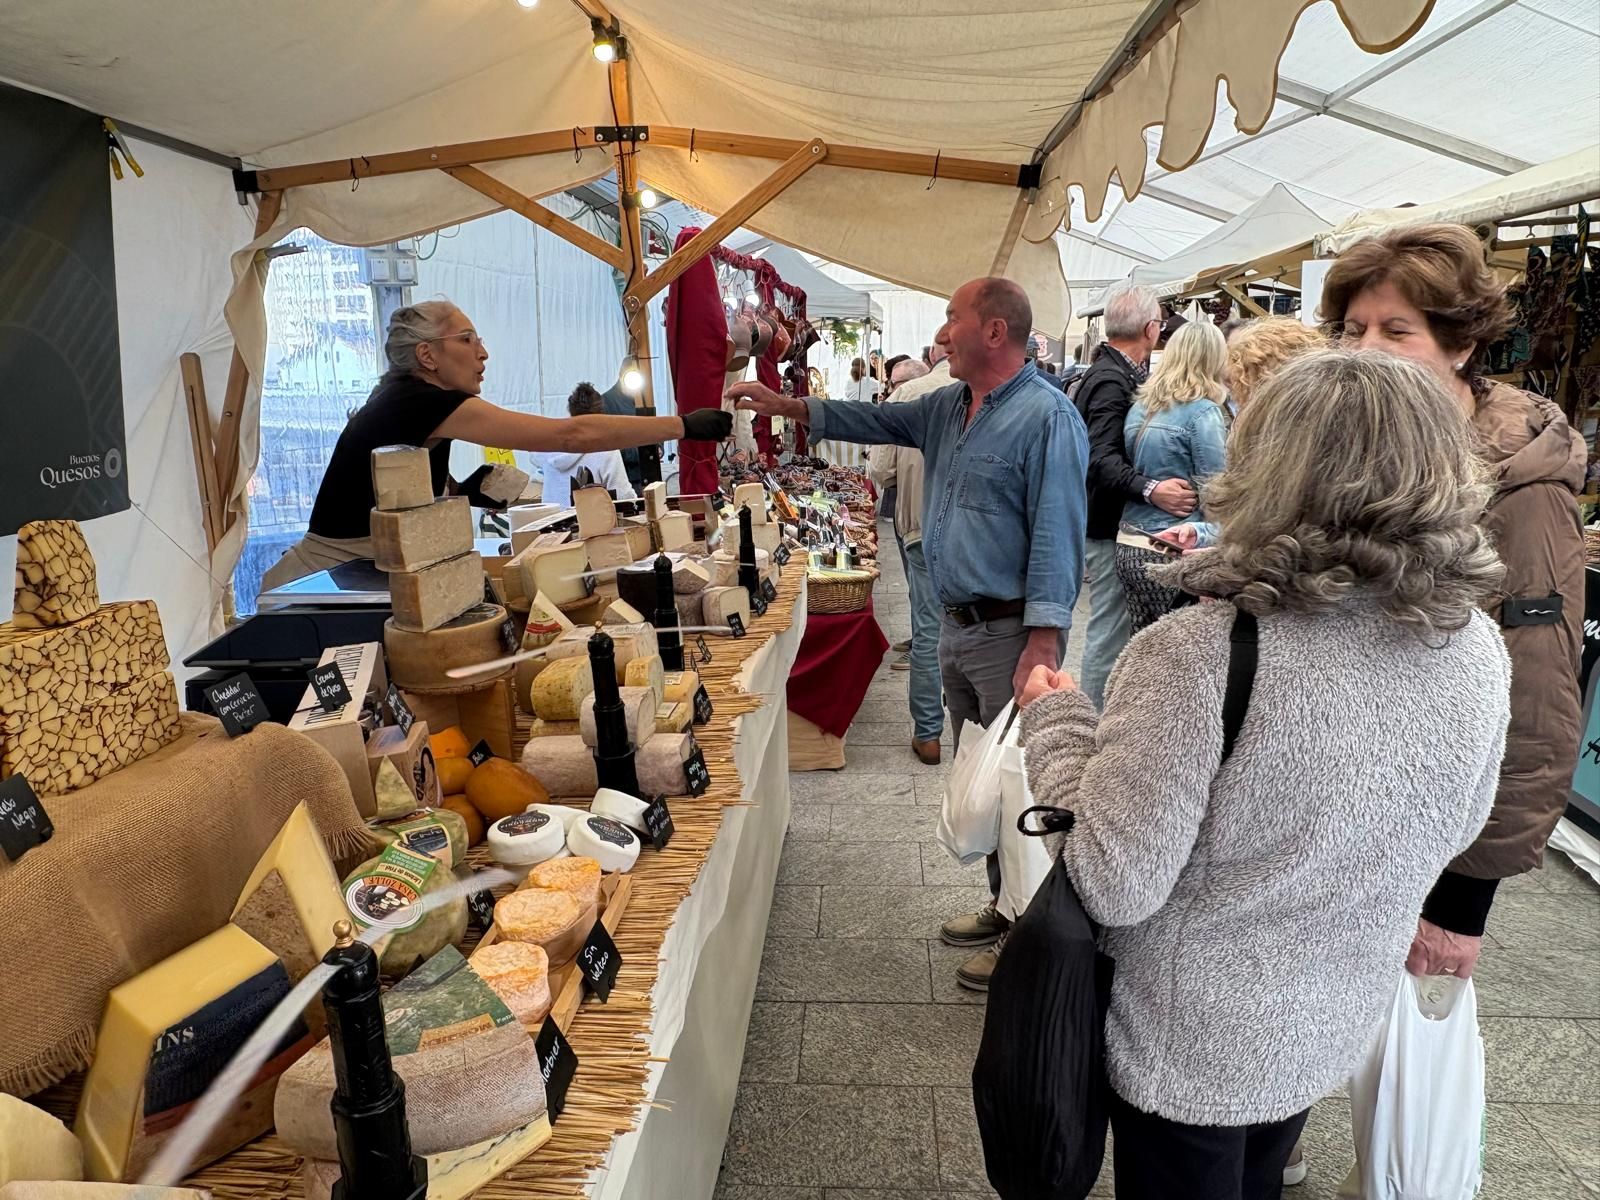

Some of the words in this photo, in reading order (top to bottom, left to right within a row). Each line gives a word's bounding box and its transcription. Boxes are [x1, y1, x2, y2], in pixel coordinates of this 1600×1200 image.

[70, 454, 100, 465] Buenos
[40, 465, 101, 488] Quesos
[211, 681, 241, 703] Cheddar
[584, 944, 597, 965] Sin
[154, 1026, 194, 1052] INS
[540, 1036, 560, 1082] orbier
